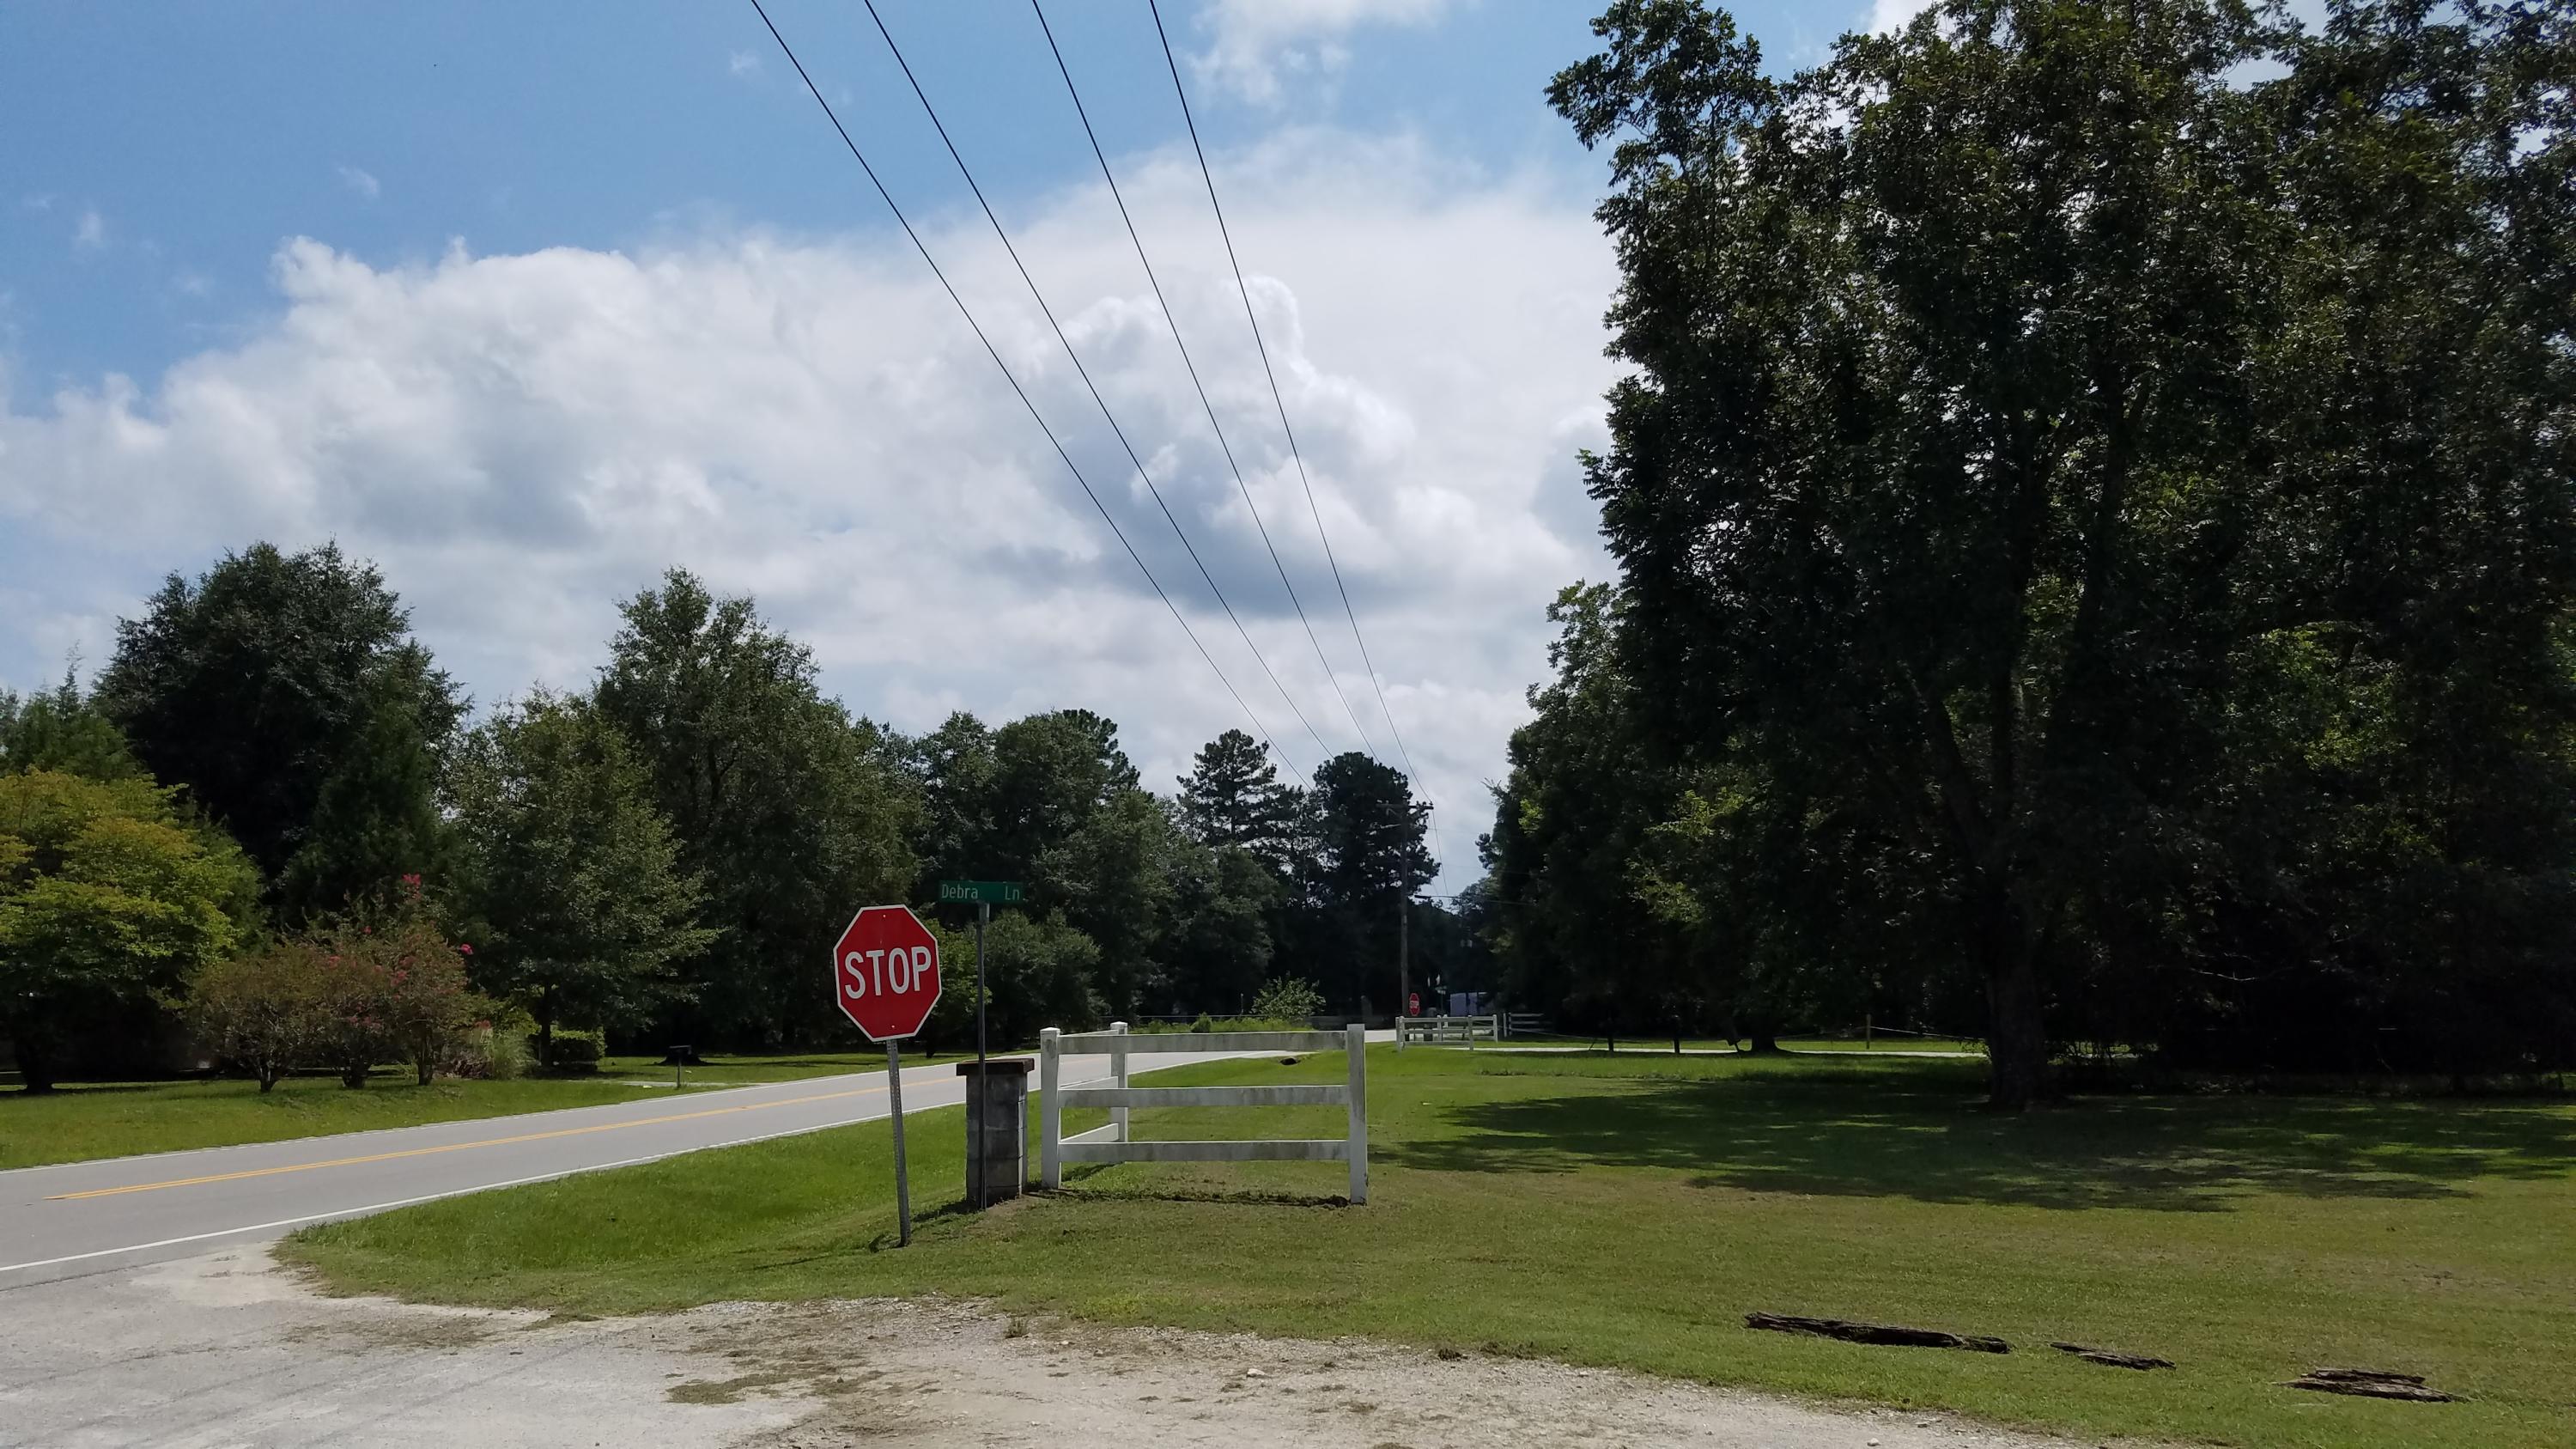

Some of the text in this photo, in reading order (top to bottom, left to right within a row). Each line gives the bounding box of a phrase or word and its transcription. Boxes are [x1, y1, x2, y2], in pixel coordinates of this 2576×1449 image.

[941, 884, 1020, 901] Debra Ln
[845, 946, 932, 1000] STOP
